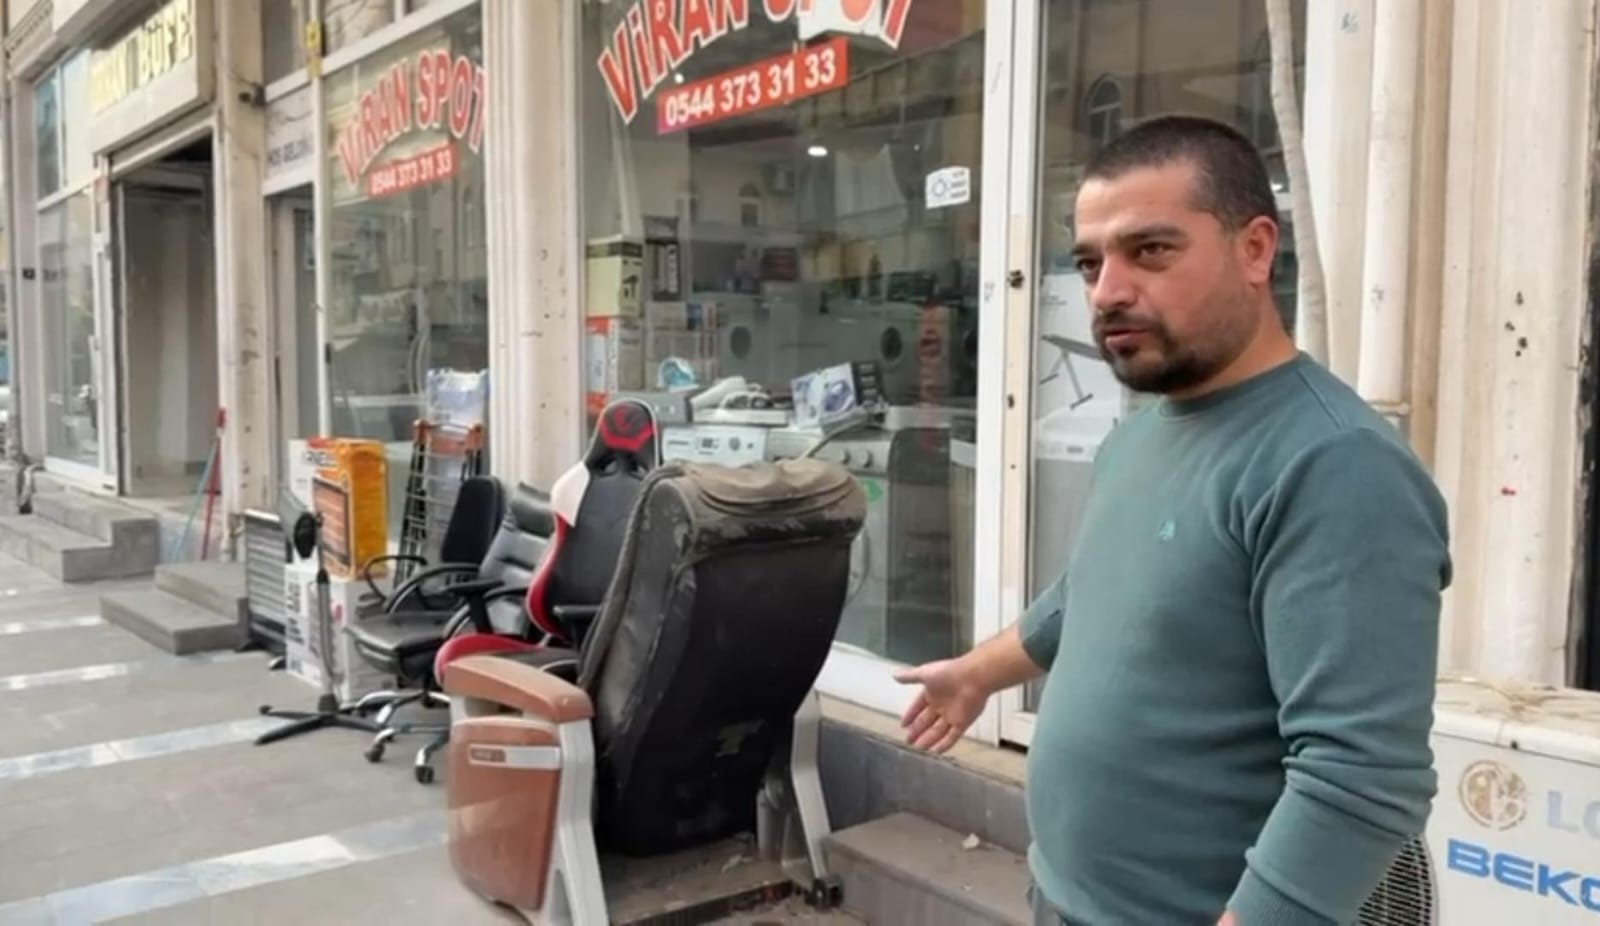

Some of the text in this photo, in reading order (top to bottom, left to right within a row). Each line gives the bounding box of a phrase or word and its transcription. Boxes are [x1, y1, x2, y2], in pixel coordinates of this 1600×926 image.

[665, 48, 836, 127] 0544 373 31 33
